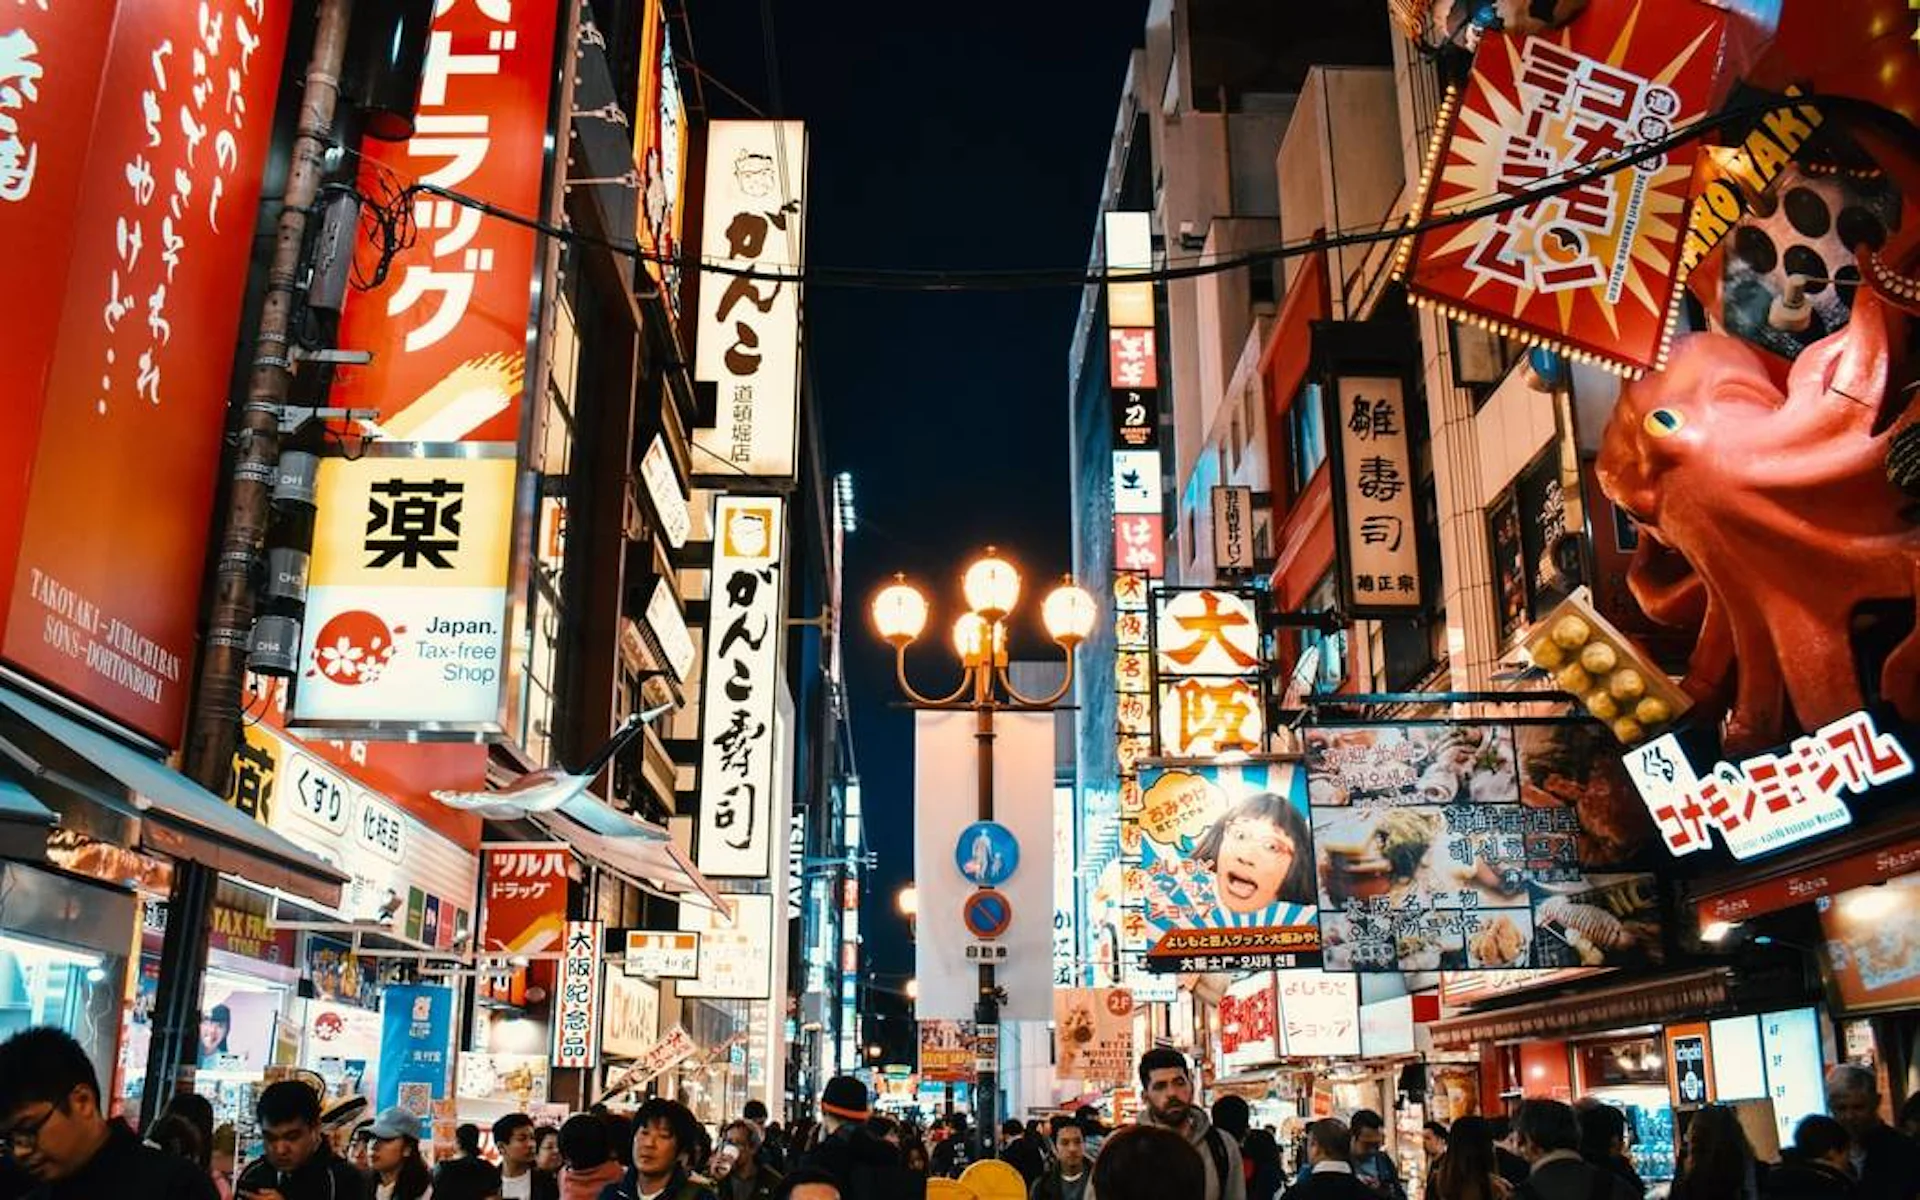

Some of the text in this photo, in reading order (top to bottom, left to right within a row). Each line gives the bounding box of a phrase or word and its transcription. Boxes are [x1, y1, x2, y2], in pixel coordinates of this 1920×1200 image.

[716, 199, 800, 377] がんこ
[731, 385, 753, 462] 道頓堀店
[364, 479, 465, 569] 薬
[416, 641, 497, 662] Tax-free
[426, 616, 498, 637] Japan.
[443, 663, 496, 685] Shop
[1162, 590, 1266, 752] 大阪
[297, 769, 343, 823] くすり
[363, 803, 401, 853] 化粧品
[493, 853, 567, 878] ツルハ
[492, 882, 551, 900] ドラッグ
[213, 907, 243, 937] TAX
[562, 931, 594, 1057] 大阪紀念品
